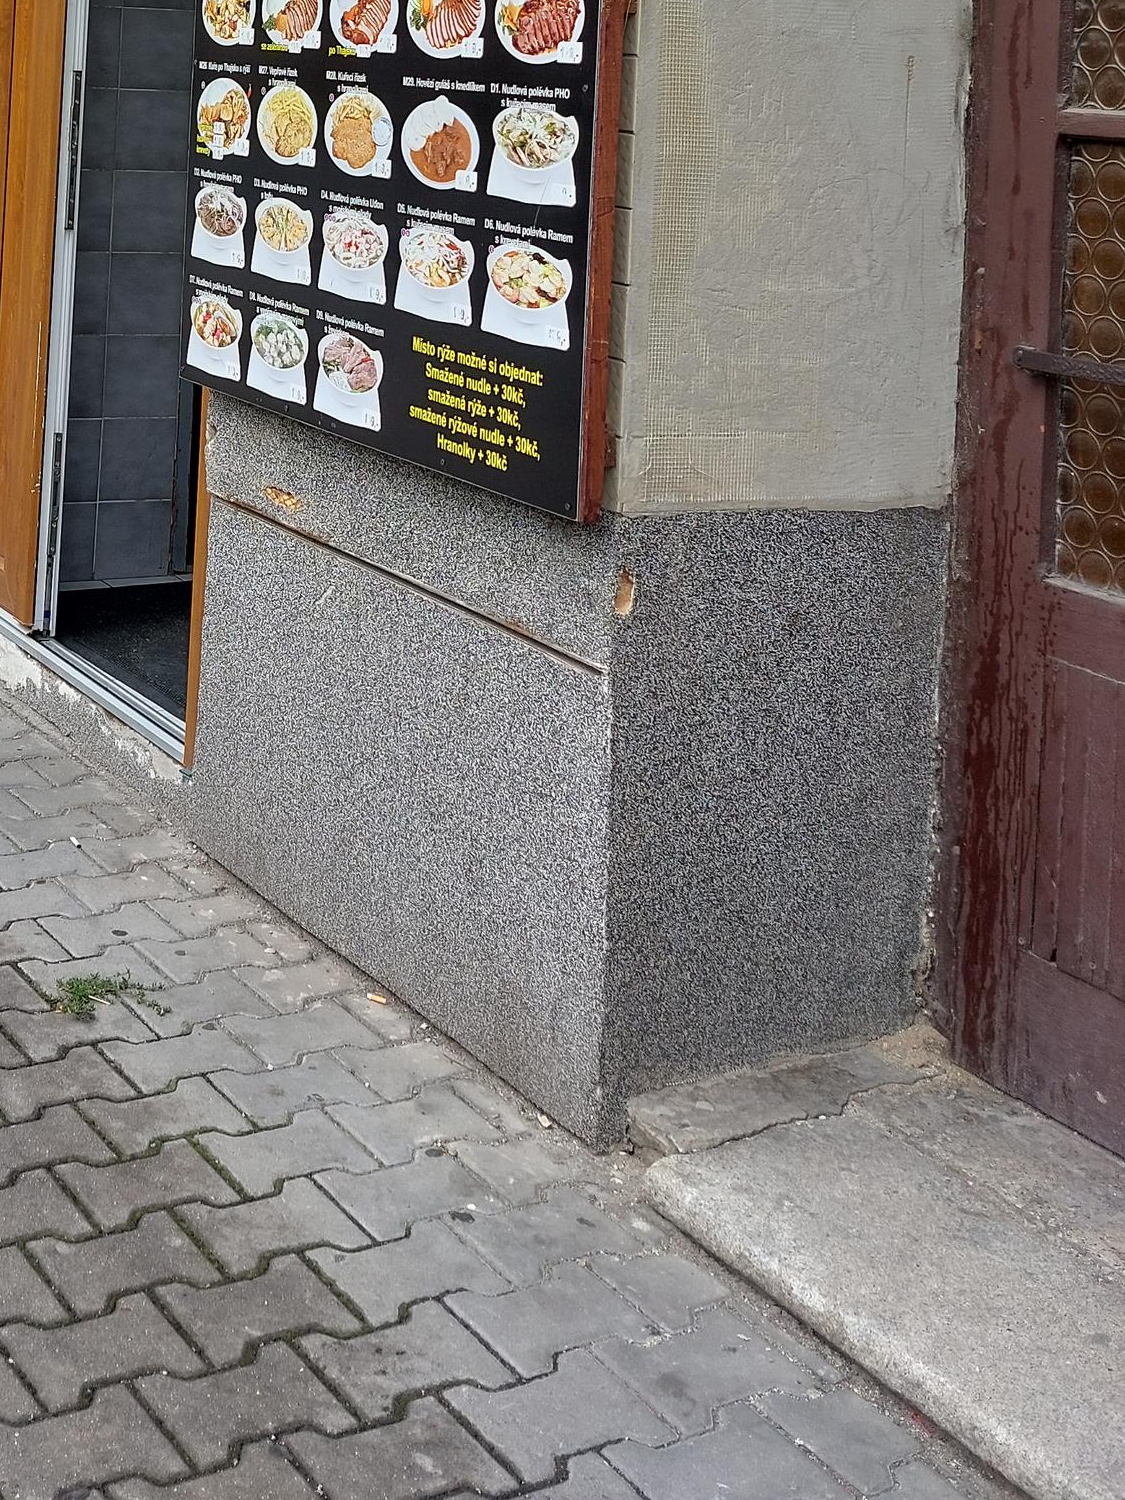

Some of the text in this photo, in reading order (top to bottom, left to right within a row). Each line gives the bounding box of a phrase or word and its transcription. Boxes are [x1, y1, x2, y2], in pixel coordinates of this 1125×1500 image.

[554, 88, 570, 99] PHO
[412, 335, 543, 391] Místo rýže možné si objednat:
[425, 361, 464, 388] Smažené
[466, 373, 492, 396] nudle
[492, 383, 499, 396] +
[427, 385, 466, 411] smažená
[467, 397, 487, 421] rýže
[488, 405, 495, 418] +
[409, 401, 447, 428] smažené
[447, 413, 477, 442] rýžové
[479, 423, 505, 448] nudle
[506, 434, 513, 448] +
[436, 432, 476, 464] Hranolky
[477, 448, 483, 461] +
